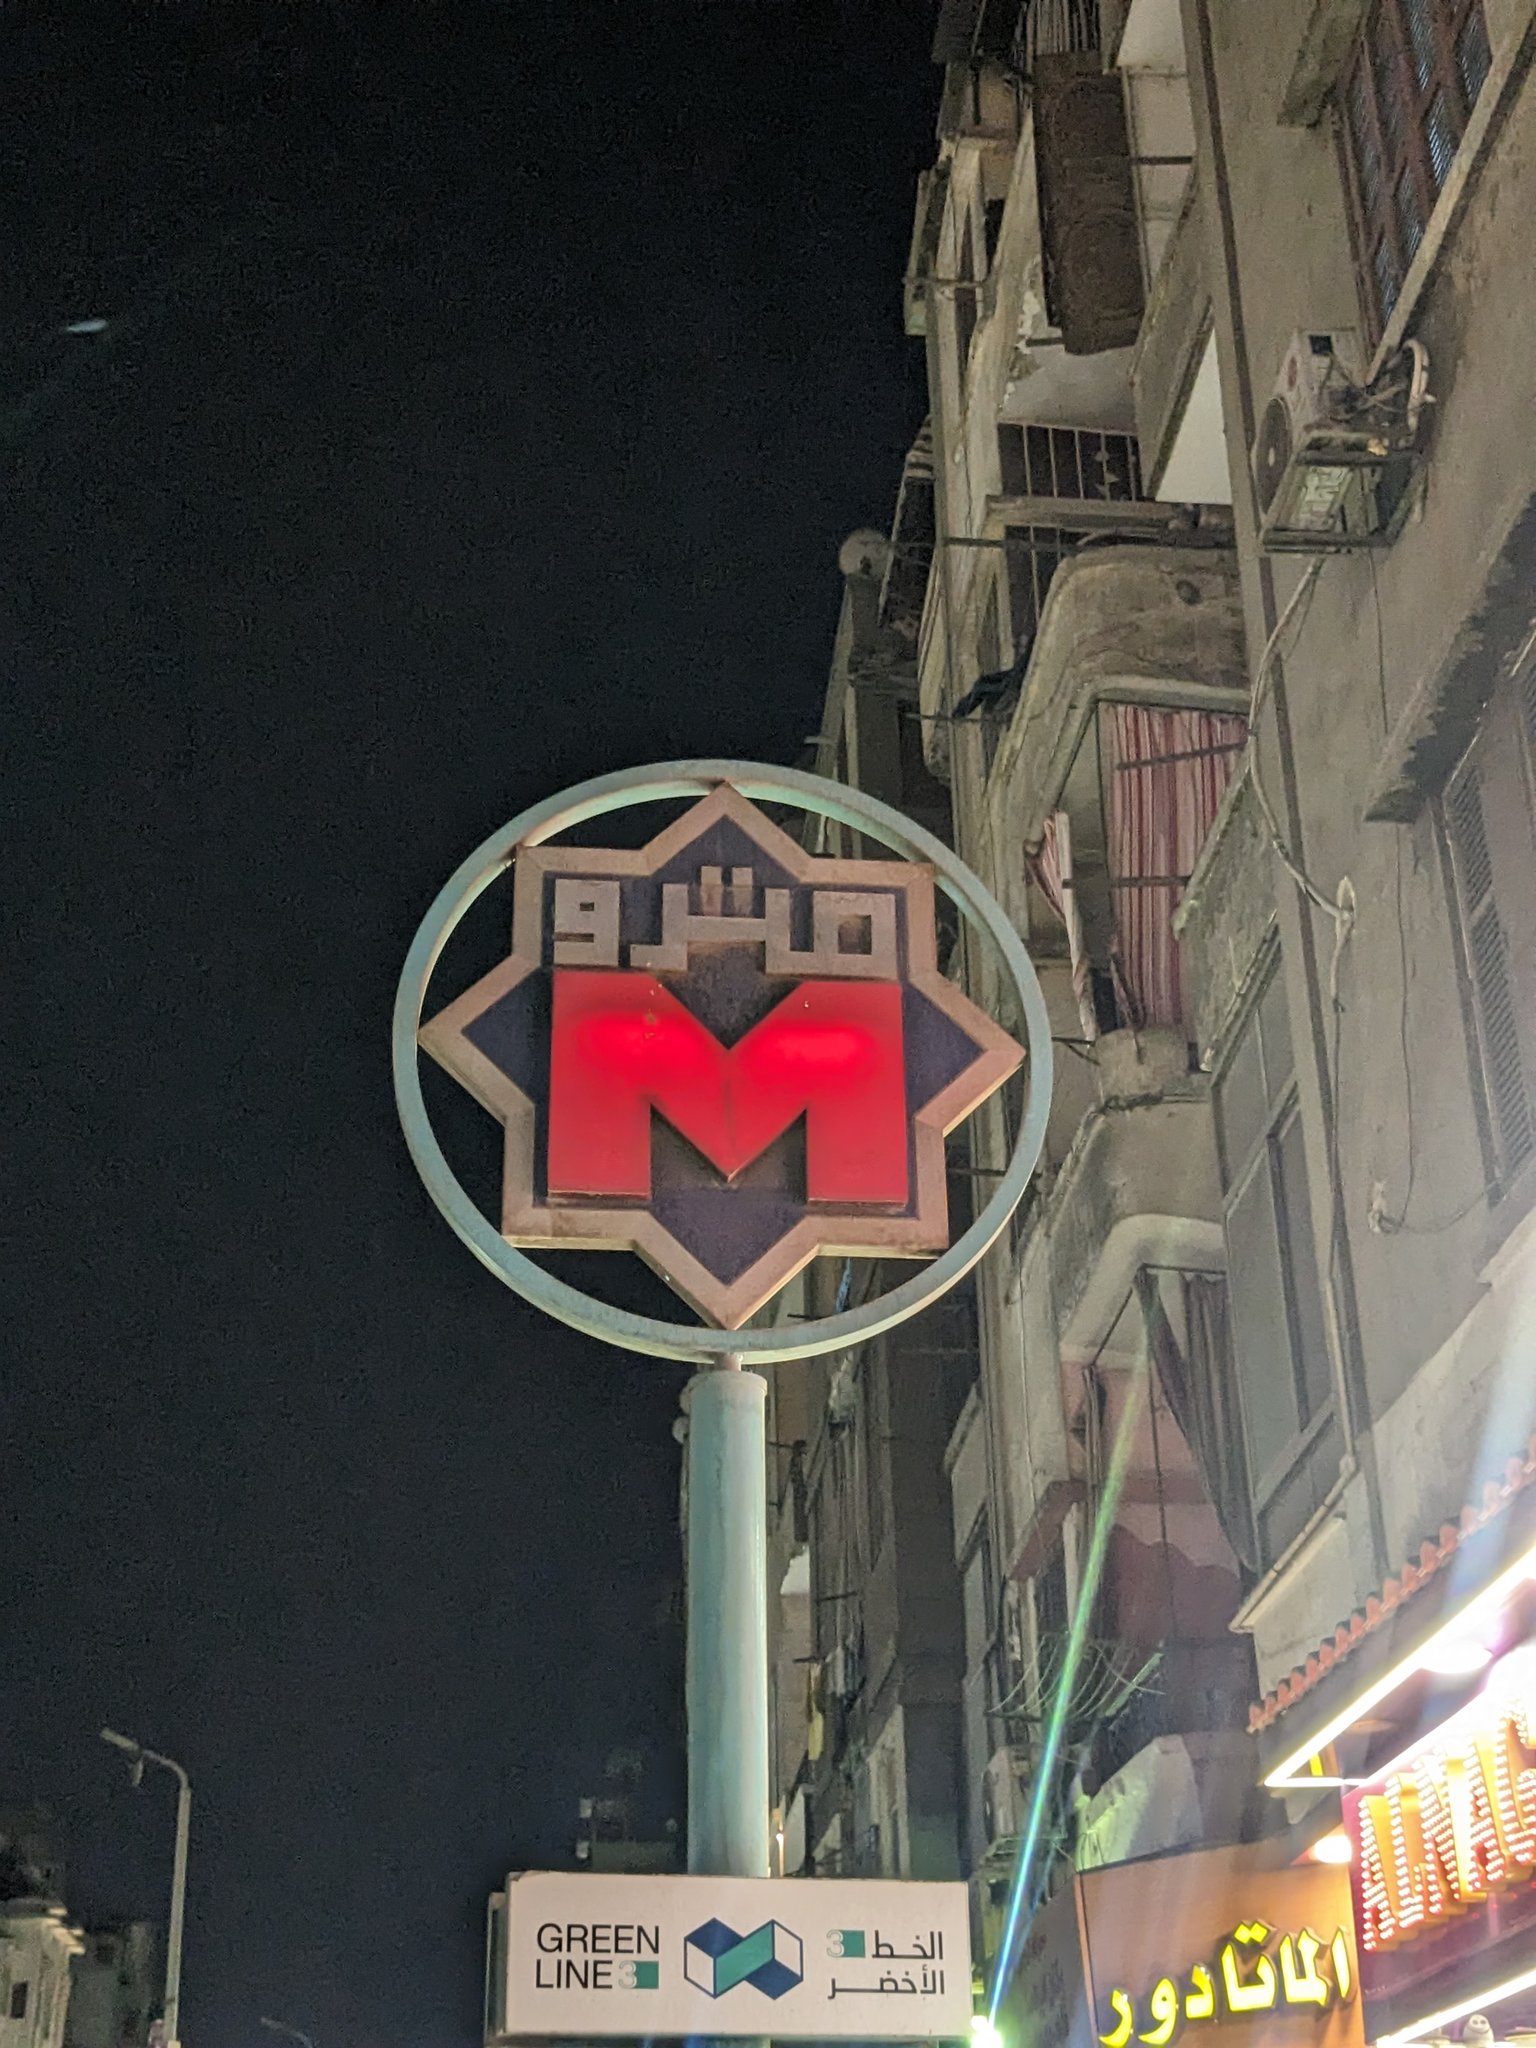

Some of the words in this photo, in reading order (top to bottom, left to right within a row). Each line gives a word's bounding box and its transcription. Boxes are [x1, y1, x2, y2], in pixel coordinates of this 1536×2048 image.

[553, 866, 897, 979] مترو
[547, 971, 908, 1204] M
[536, 1922, 660, 1955] GREEN
[826, 1928, 845, 1959] 3
[871, 1929, 944, 1961] الخط
[535, 1958, 613, 1990] LINE
[826, 1963, 945, 2001] الأخضر
[1098, 1921, 1352, 2048] الماتادور
